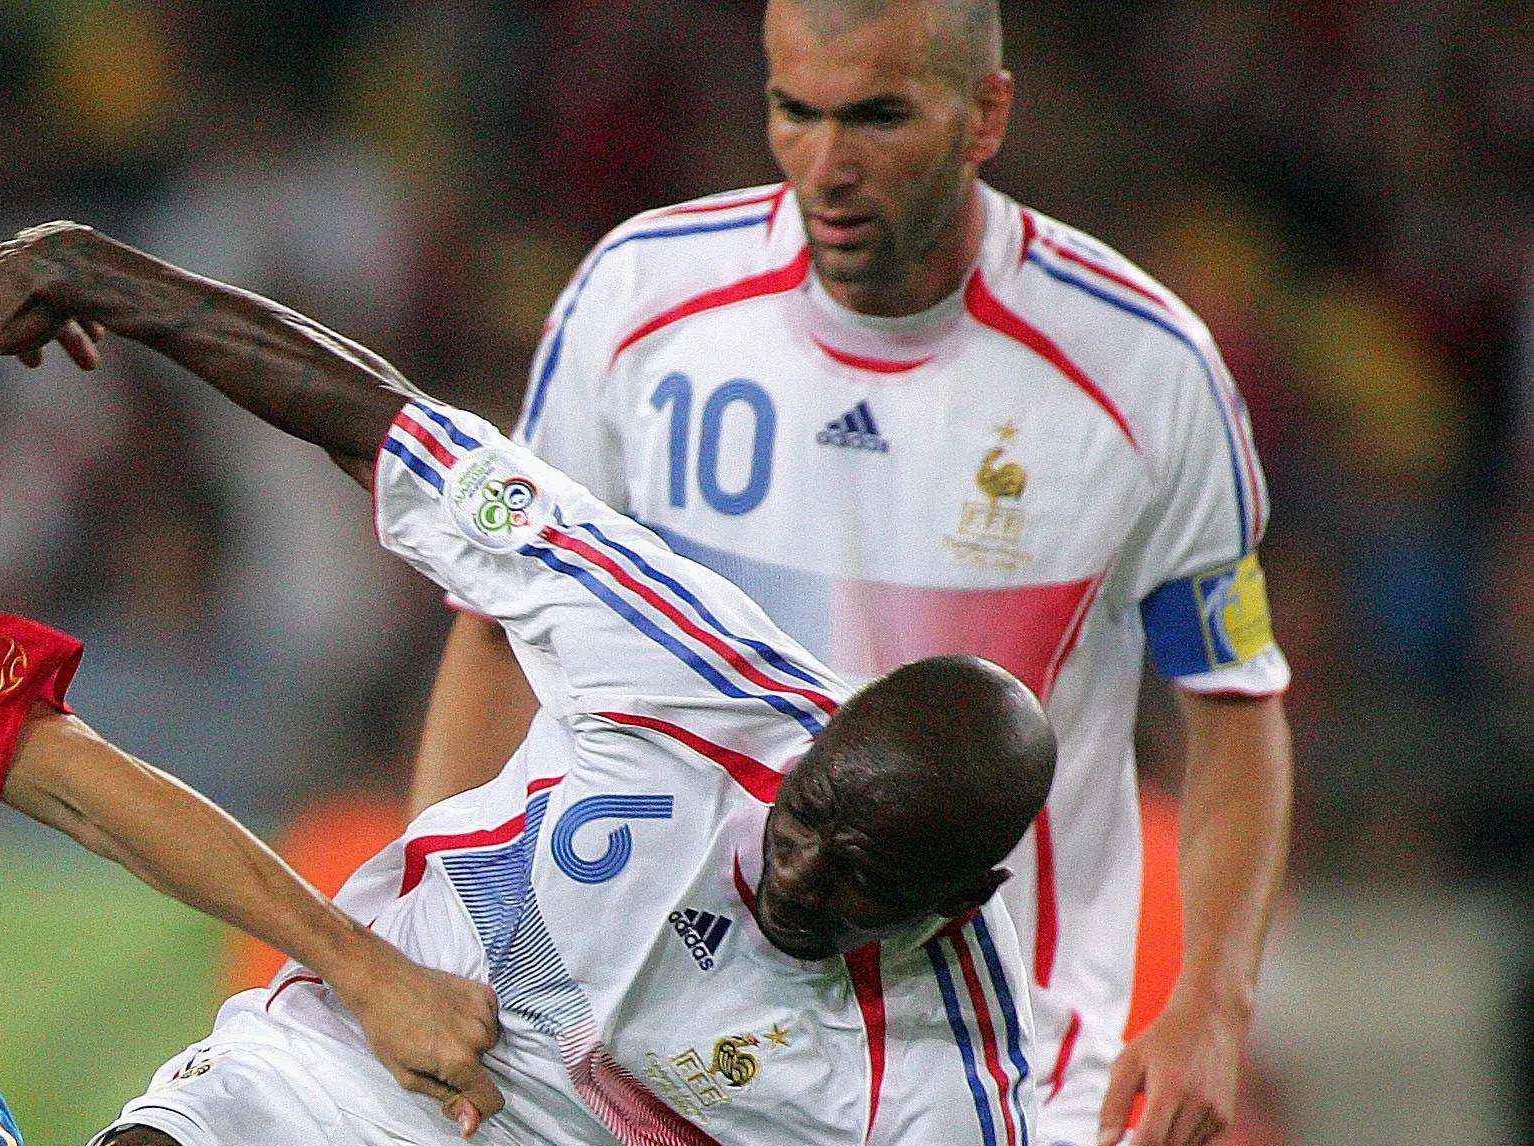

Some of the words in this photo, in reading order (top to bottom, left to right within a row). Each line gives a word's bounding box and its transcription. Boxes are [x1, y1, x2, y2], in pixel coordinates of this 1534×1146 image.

[650, 371, 776, 516] 10
[551, 794, 674, 884] 6
[668, 910, 714, 971] adidas
